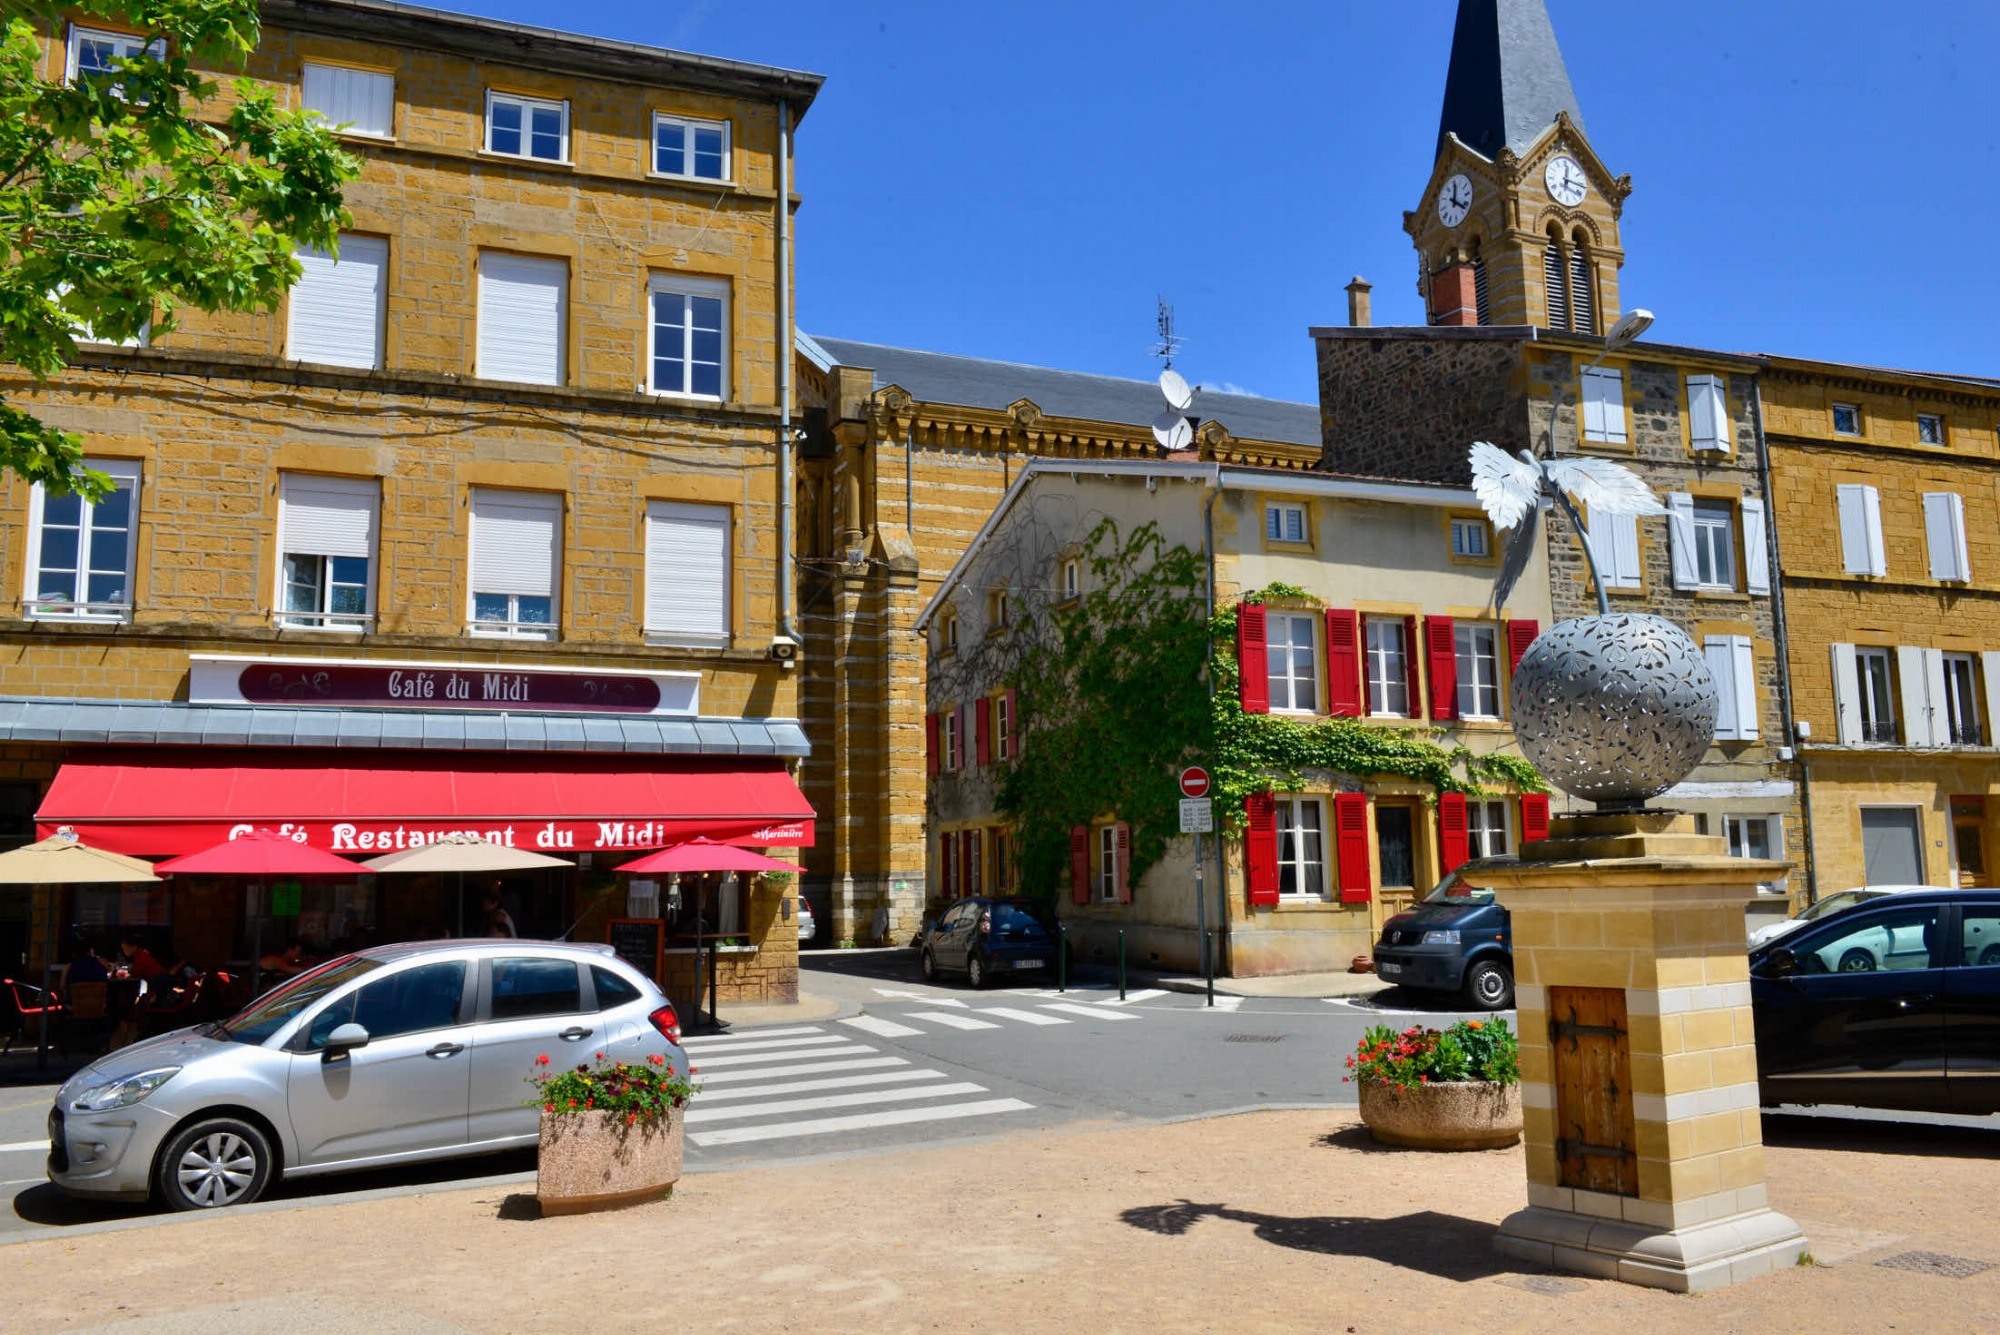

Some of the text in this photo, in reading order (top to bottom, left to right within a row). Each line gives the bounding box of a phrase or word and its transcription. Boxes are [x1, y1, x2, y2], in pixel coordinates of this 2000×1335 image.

[388, 670, 531, 701] Café du Midi
[536, 821, 574, 848] du
[594, 821, 665, 847] Midi
